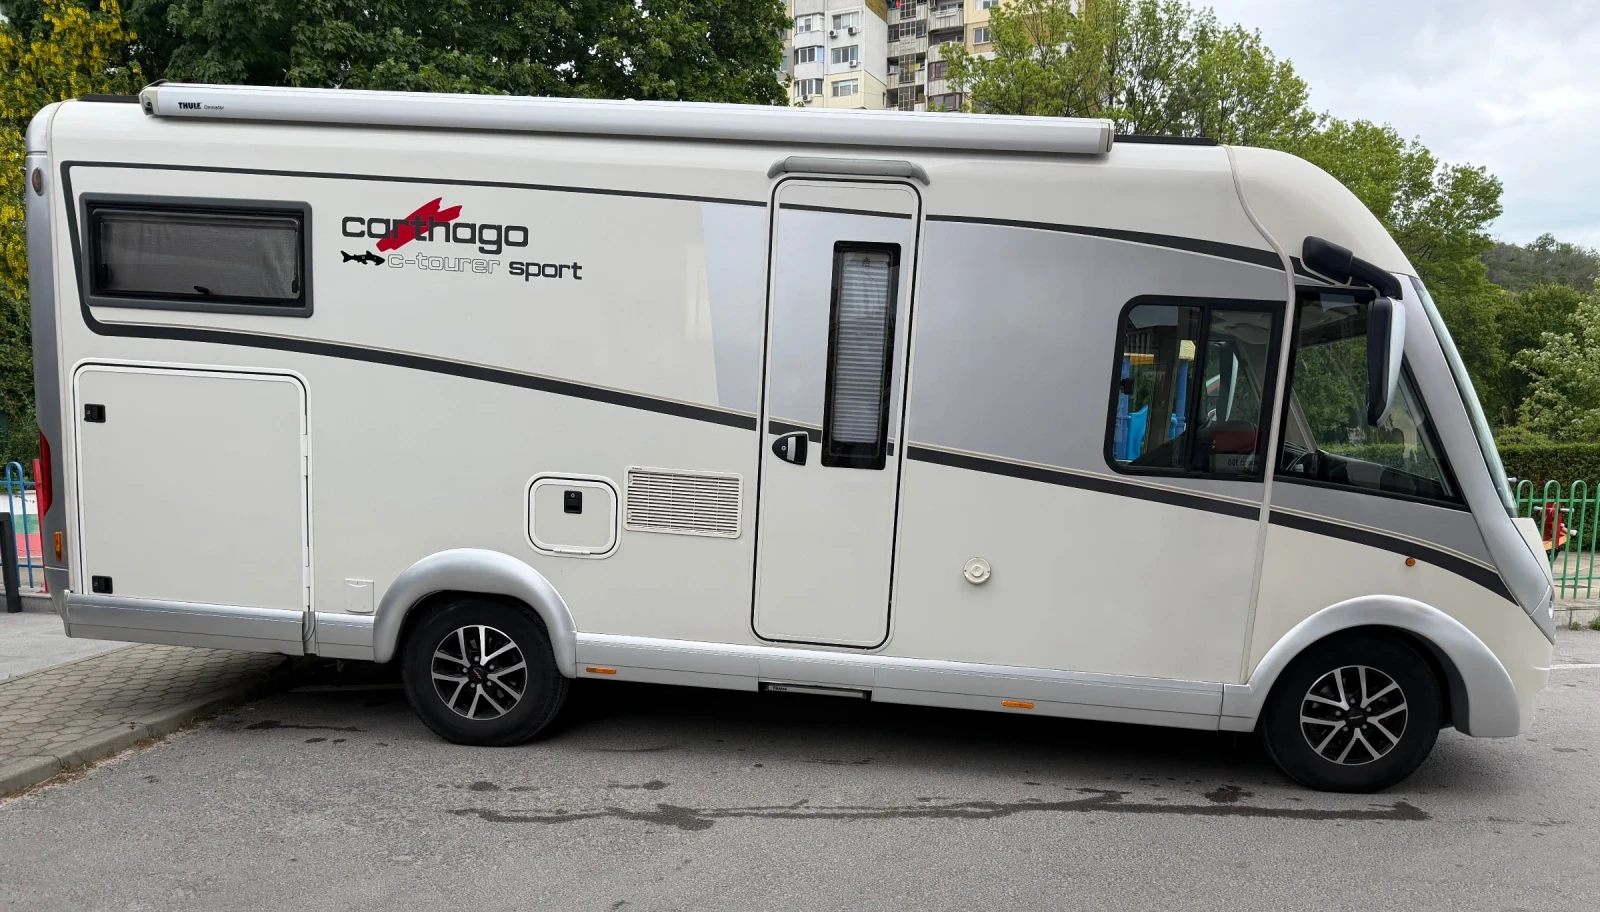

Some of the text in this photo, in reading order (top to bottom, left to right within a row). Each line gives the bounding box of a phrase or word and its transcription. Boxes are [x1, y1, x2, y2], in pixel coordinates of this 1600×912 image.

[342, 216, 528, 255] carthago
[388, 252, 582, 282] c-tourer sport
